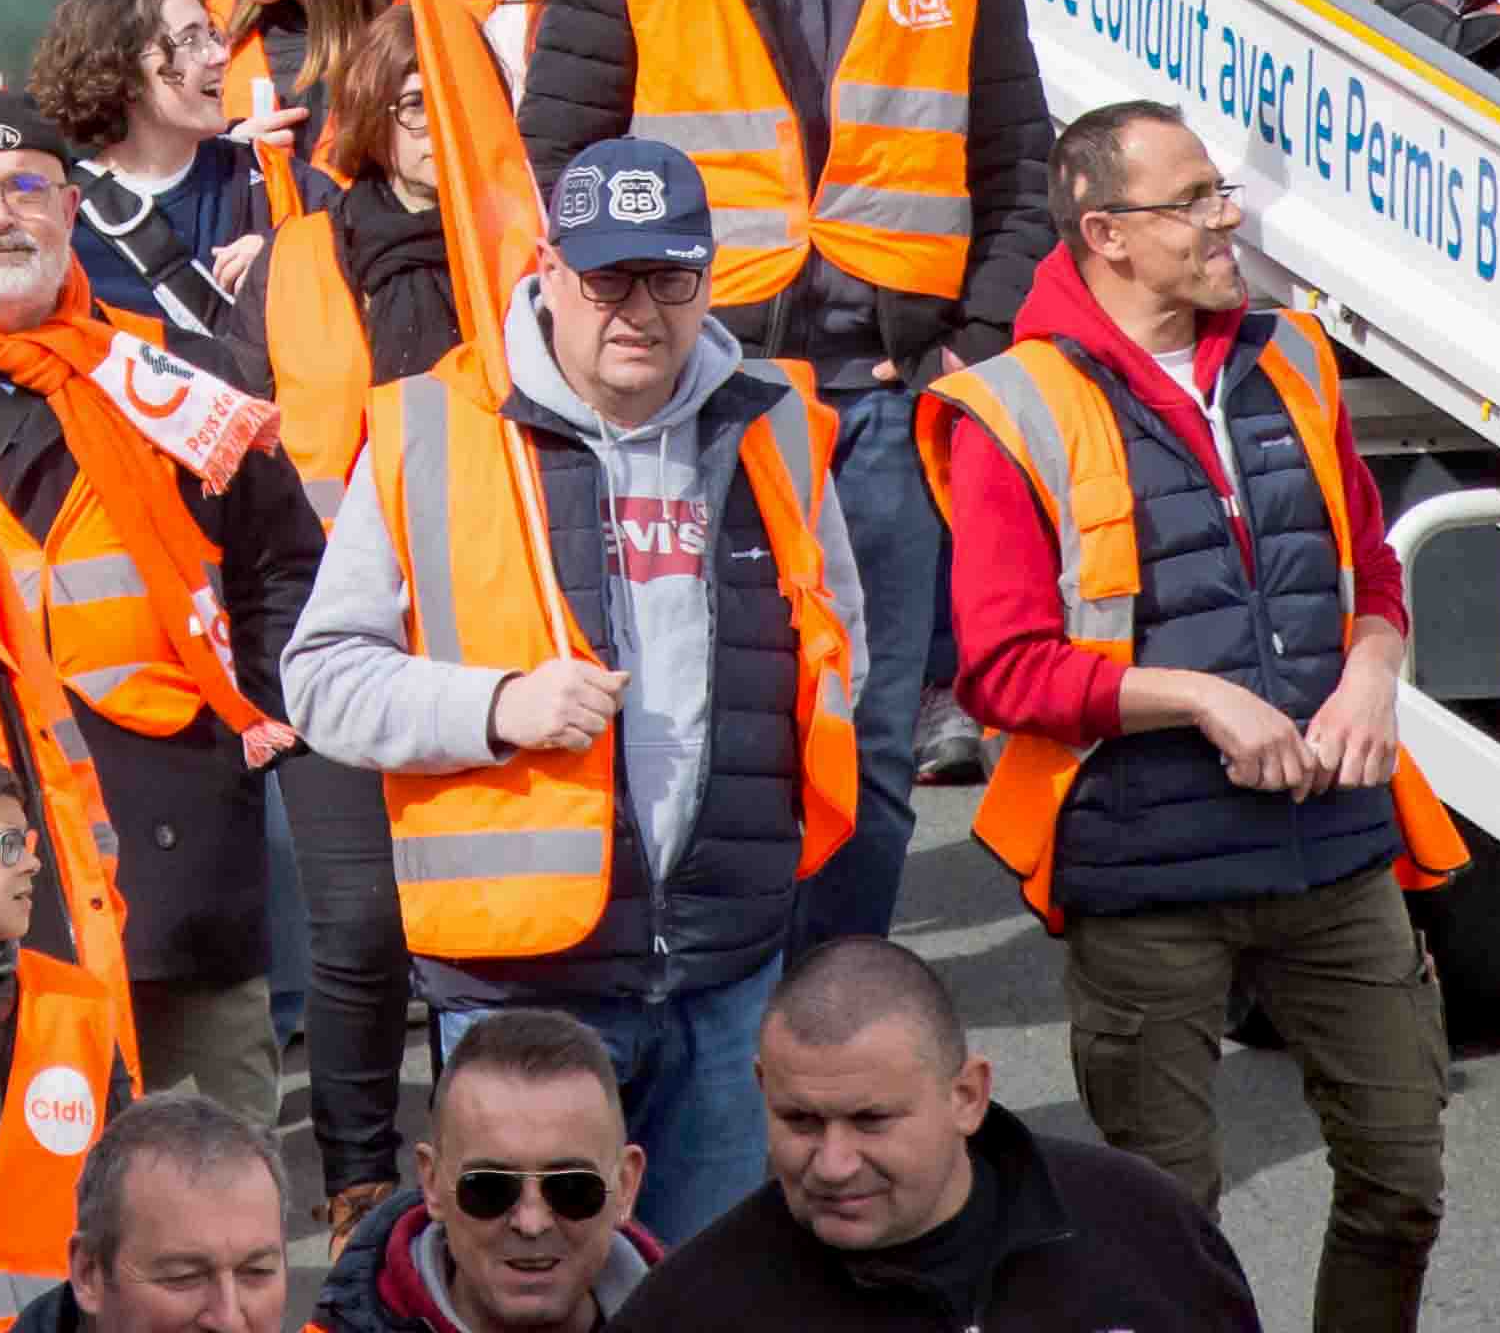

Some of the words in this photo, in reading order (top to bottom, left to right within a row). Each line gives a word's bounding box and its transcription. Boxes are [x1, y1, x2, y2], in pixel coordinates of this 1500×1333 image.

[1218, 23, 1295, 152] avec
[1304, 49, 1333, 181] le
[1346, 77, 1466, 263] Permis
[1476, 156, 1499, 282] B
